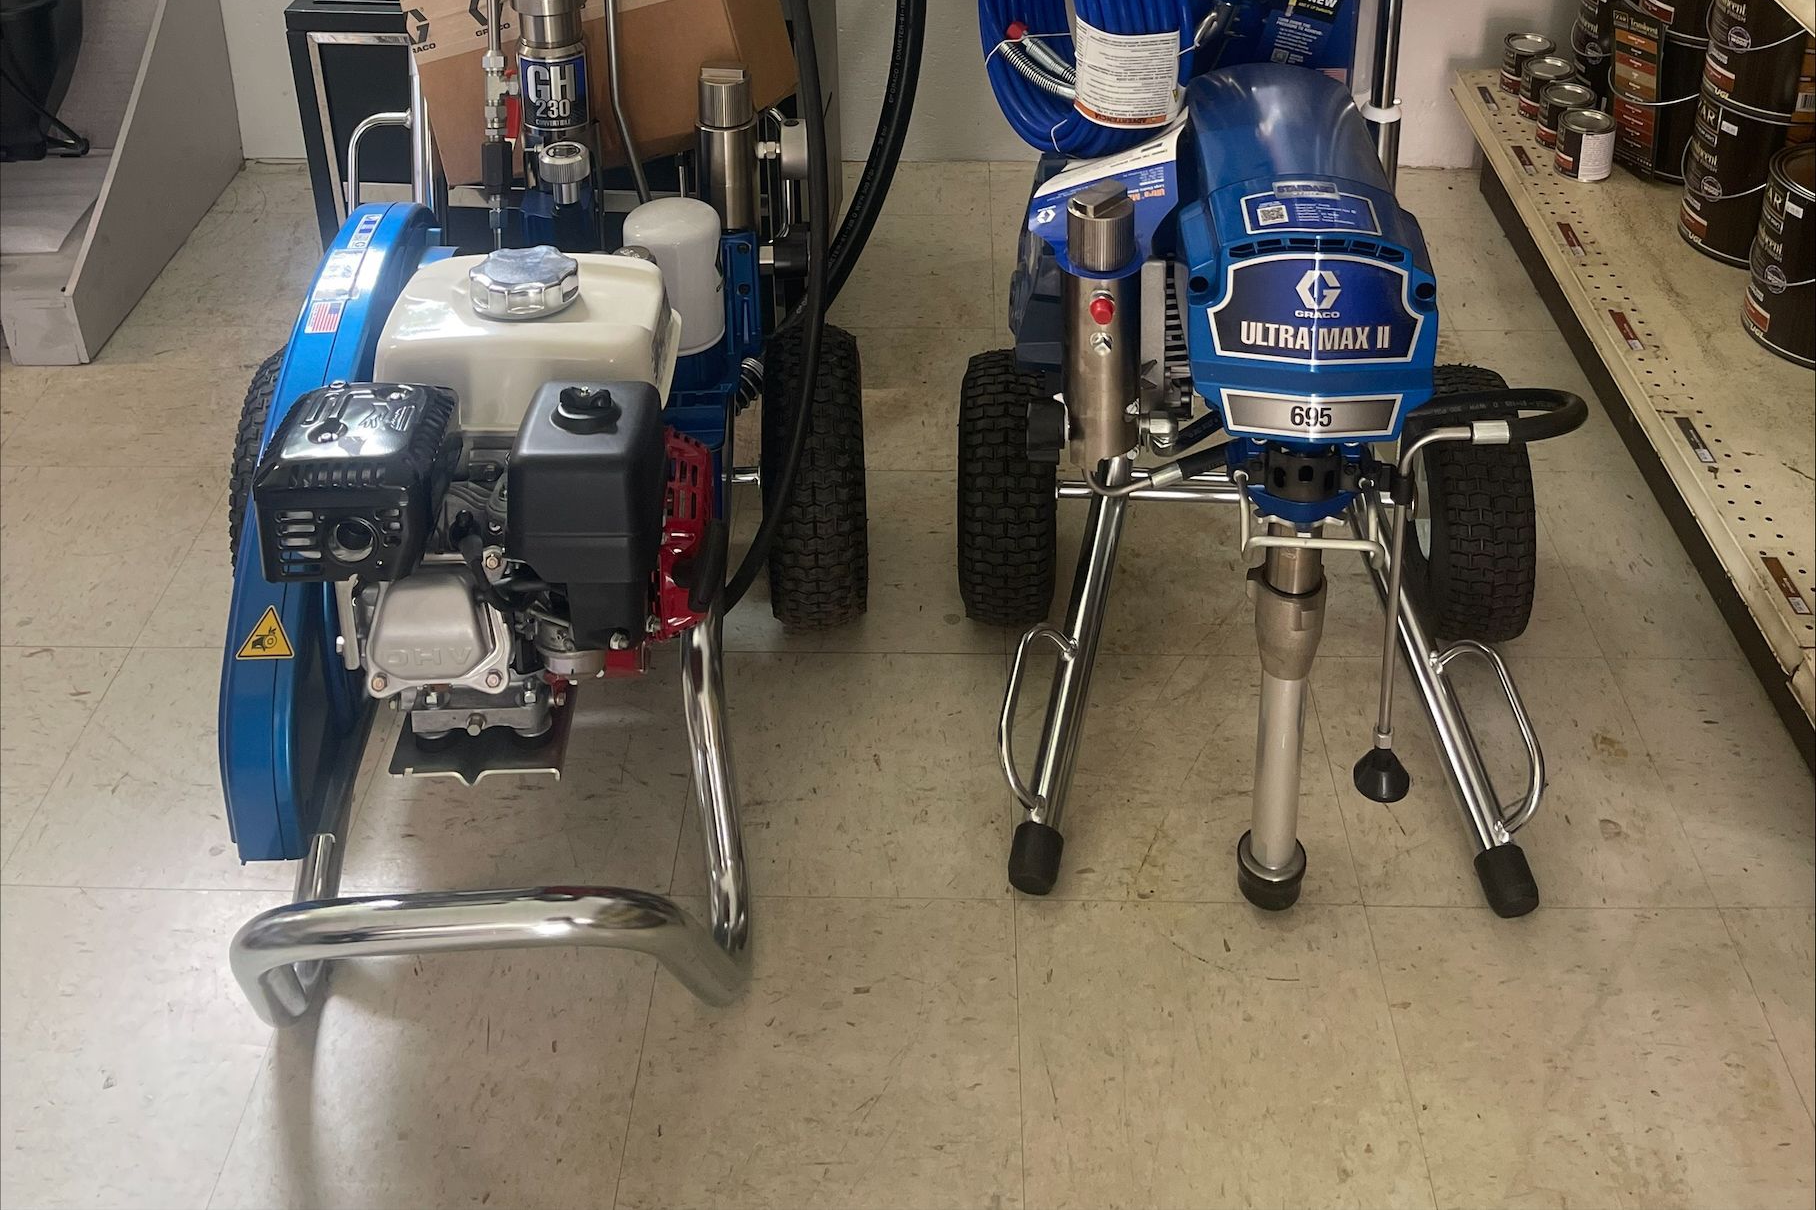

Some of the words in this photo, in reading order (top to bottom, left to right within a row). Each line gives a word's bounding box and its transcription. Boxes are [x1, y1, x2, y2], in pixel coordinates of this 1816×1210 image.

[475, 22, 511, 37] GRCO
[413, 42, 436, 54] RACO
[527, 64, 576, 103] GH
[1715, 88, 1730, 100] UGL
[535, 98, 571, 119] 230
[1094, 112, 1147, 125] ADVERTENCIA
[1276, 184, 1336, 194] STANDARD
[1689, 231, 1703, 245] UGL
[1294, 310, 1341, 319] GRACO
[1240, 321, 1310, 351] ULTRA
[1318, 326, 1370, 351] MAX
[1376, 325, 1391, 349] II
[1750, 324, 1765, 339] UGL
[1290, 405, 1333, 428] 695
[387, 647, 472, 666] OHV
